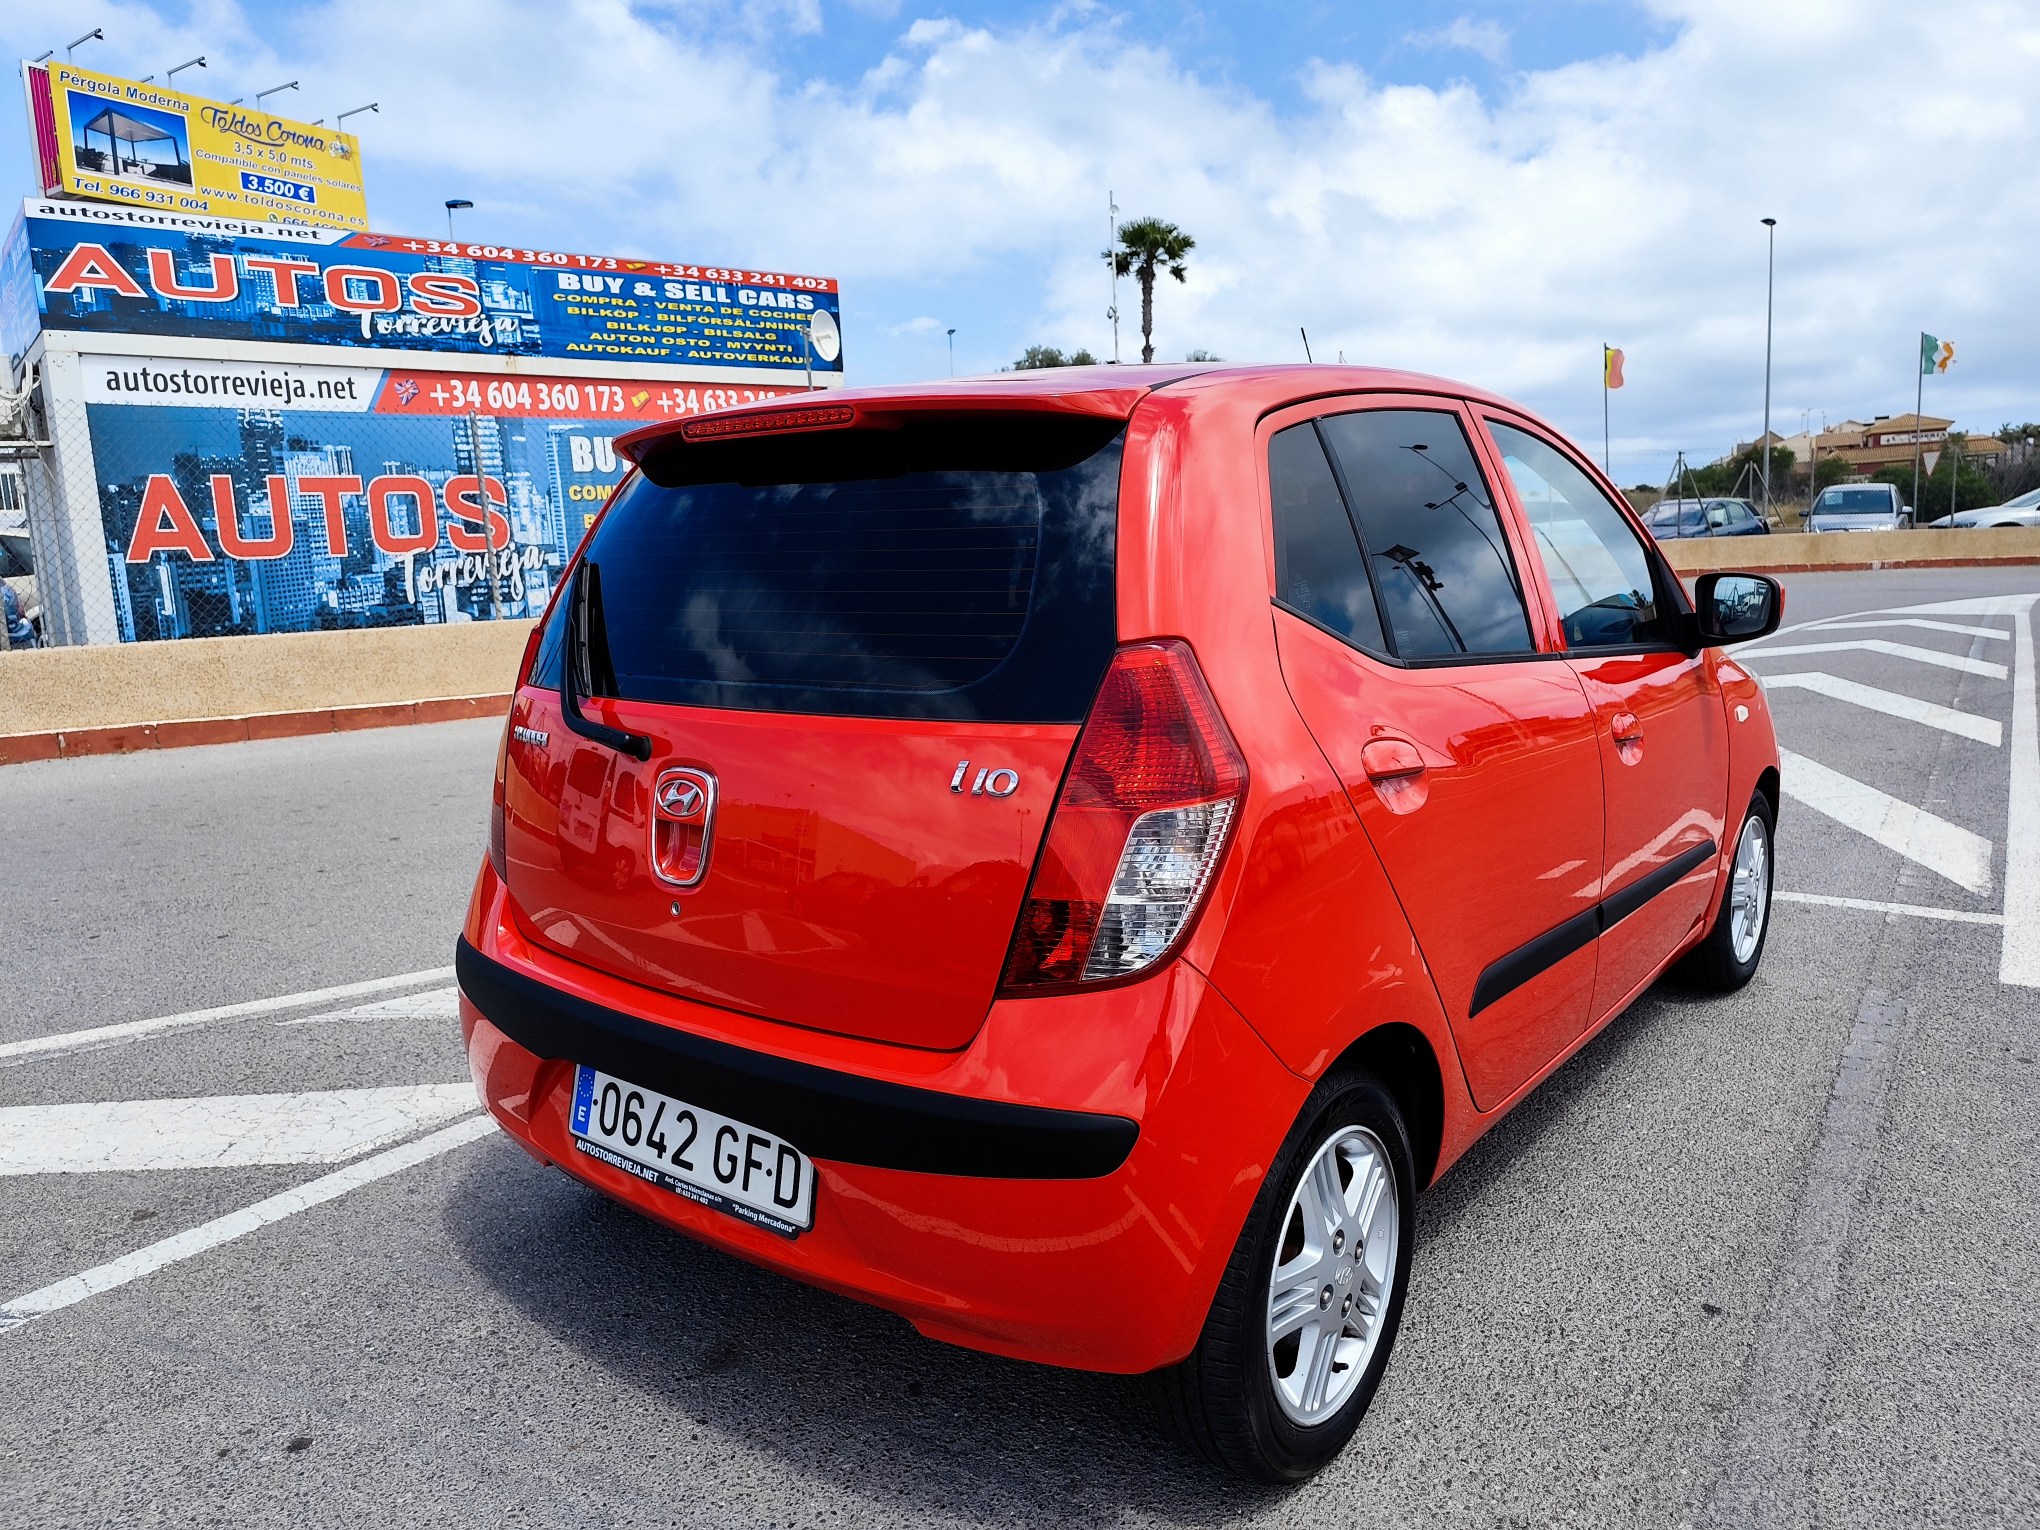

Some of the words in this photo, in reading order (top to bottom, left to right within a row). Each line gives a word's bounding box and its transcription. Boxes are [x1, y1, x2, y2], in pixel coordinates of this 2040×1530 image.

[60, 70, 120, 96] Pérgola
[126, 87, 190, 111] Moderna
[201, 106, 263, 137] Toldos
[267, 121, 325, 151] Corona
[195, 149, 259, 169] Compatible
[262, 164, 281, 174] con
[284, 169, 323, 184] paneles
[326, 178, 362, 192] solares
[234, 142, 252, 155] 3,5
[257, 149, 264, 158] x
[268, 150, 287, 163] 5,0
[291, 156, 317, 170] mts.
[73, 177, 103, 193] Tel.
[109, 184, 141, 199] 966
[145, 193, 174, 205] 931
[180, 199, 208, 211] 004
[248, 176, 294, 197] 3.500
[298, 187, 310, 201] €
[39, 204, 322, 239] autostorrevieja.net
[201, 186, 365, 226] www.toldoscorona.es
[403, 241, 460, 254] +34
[466, 245, 515, 260] 604
[522, 250, 568, 265] 360
[575, 255, 618, 269] 173
[43, 242, 482, 319] AUTOS
[557, 272, 624, 294] BUY
[633, 282, 657, 297] &
[664, 282, 732, 303] SELL
[738, 289, 815, 310] CARS
[654, 265, 700, 277] +34
[705, 269, 743, 281] 633
[750, 272, 786, 286] 241
[792, 278, 828, 290] 402
[553, 293, 638, 307] COMPRA
[654, 301, 715, 313] VENTA
[720, 306, 744, 316] DE
[567, 306, 639, 319] BILKÖP
[350, 308, 518, 347] Torrevieja
[590, 332, 656, 343] AUTON
[661, 337, 711, 347] OSTO
[727, 341, 793, 353] MYYNTI
[606, 321, 688, 334] BILKJØP
[704, 328, 777, 340] BILSALG
[566, 343, 671, 356] AUTOKAUF
[106, 367, 358, 405] autostorrevieja.net
[429, 379, 482, 408] +34
[487, 381, 532, 410] 604
[536, 383, 580, 411] 360
[585, 385, 625, 412] 173
[656, 388, 699, 414] +34
[703, 390, 738, 412] 633
[569, 485, 617, 501] COM
[126, 475, 512, 564] AUTOS
[577, 1105, 587, 1122] E
[576, 1139, 659, 1183] AUTOSTORREVIEJA.NET
[599, 1081, 698, 1172] 0642
[713, 1125, 802, 1209] GFD
